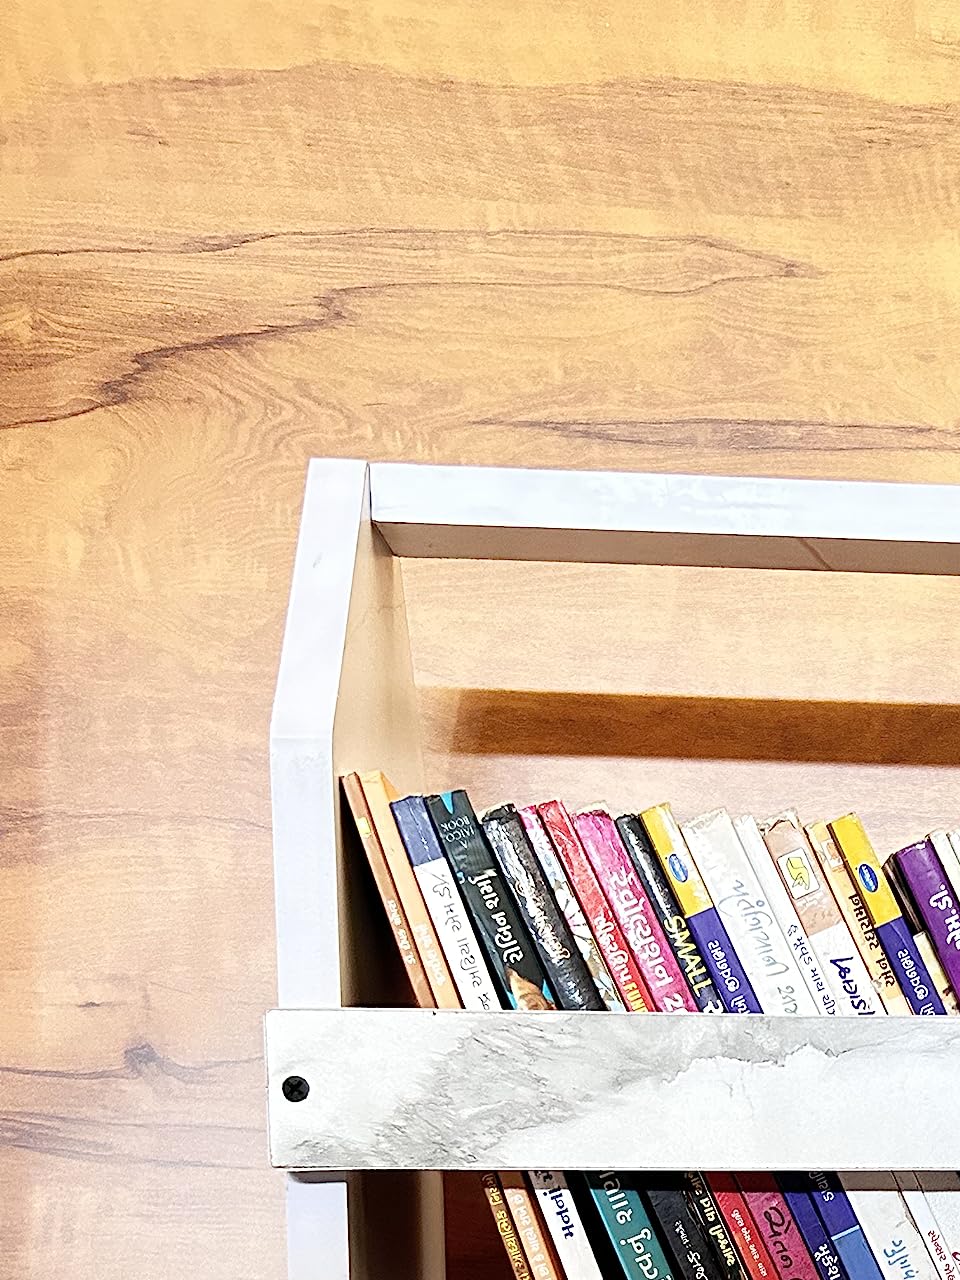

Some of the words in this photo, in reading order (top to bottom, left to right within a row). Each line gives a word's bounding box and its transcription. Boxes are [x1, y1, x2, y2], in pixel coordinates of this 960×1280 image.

[440, 815, 470, 832] BOOK
[485, 907, 525, 968] રોબિન
[660, 912, 716, 1000] SMALL
[807, 966, 826, 993] માય
[871, 950, 897, 989] એન.
[542, 1185, 574, 1239] મનનાં
[699, 1196, 717, 1222] વાત
[709, 1224, 735, 1266] આજની
[763, 1207, 793, 1268] ચેતન
